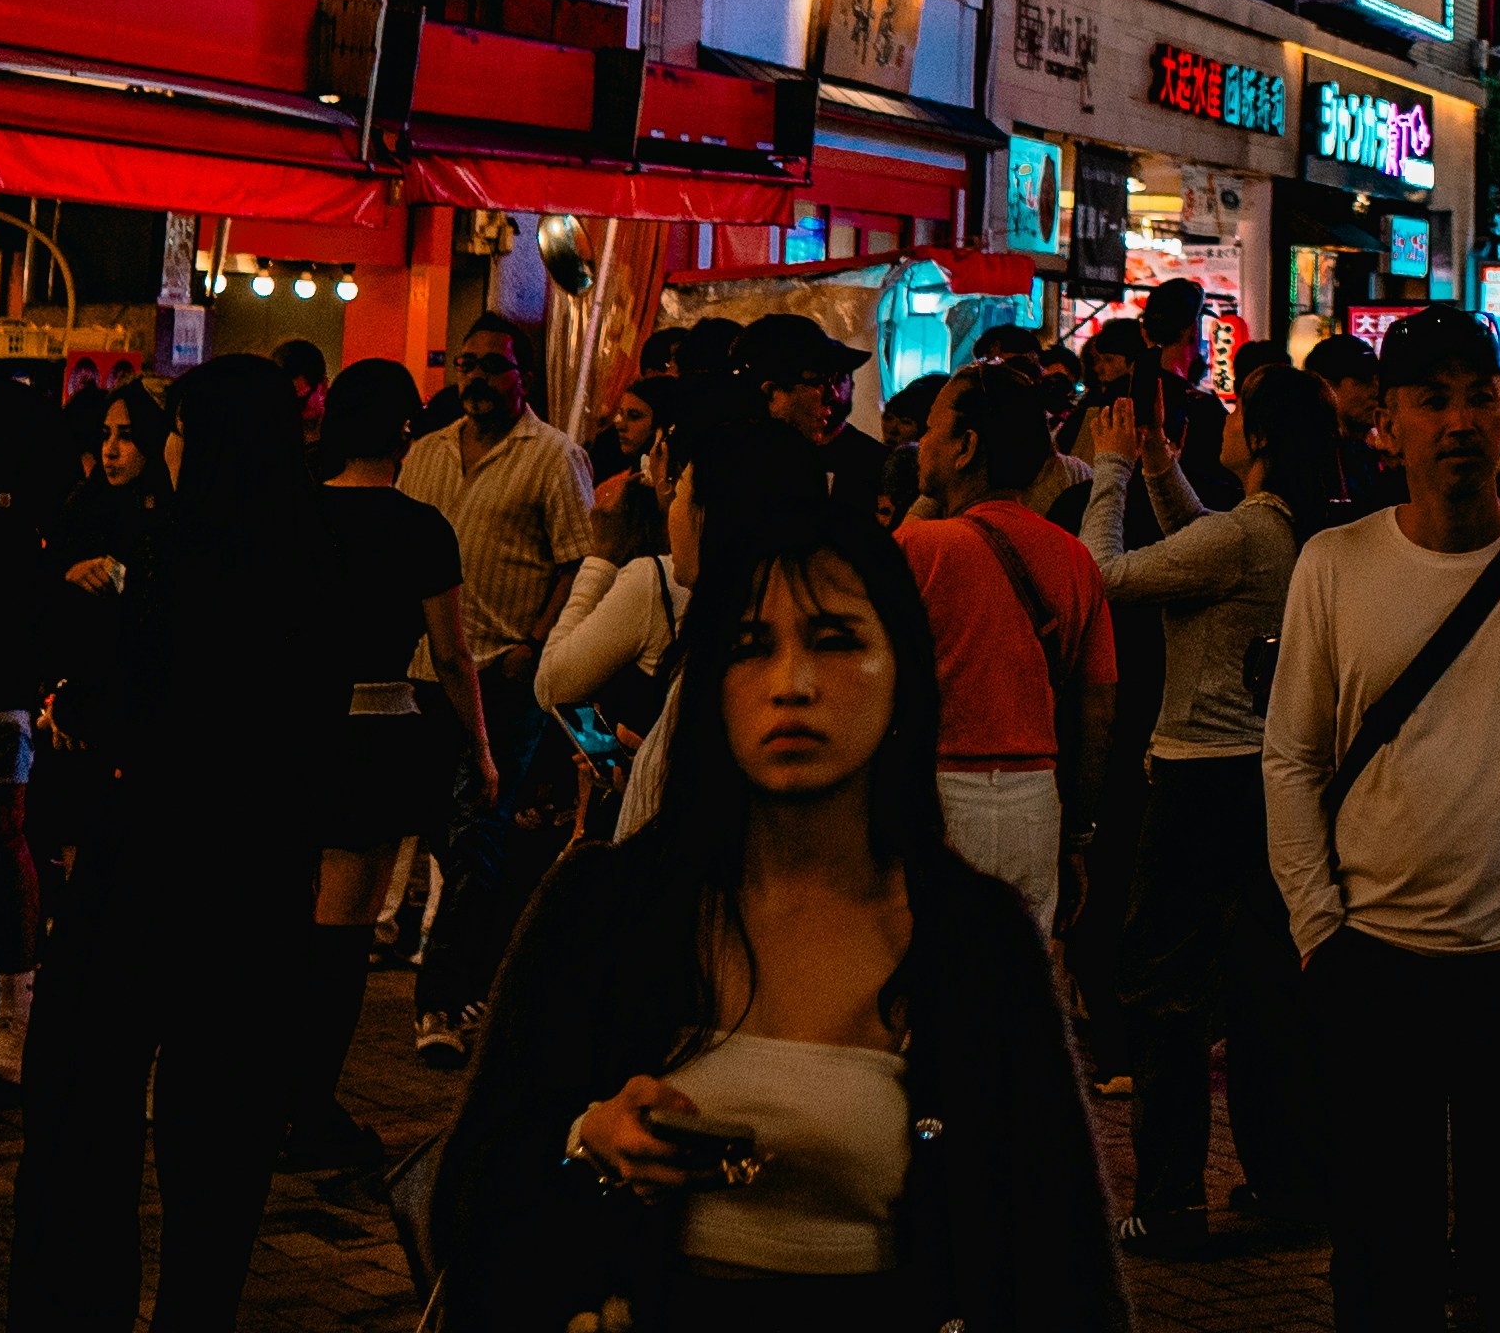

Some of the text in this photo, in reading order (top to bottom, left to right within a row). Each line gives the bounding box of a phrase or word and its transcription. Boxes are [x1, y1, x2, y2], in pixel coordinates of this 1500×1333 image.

[1159, 44, 1223, 119] 大起水産
[1319, 80, 1390, 170] ジャンカラ
